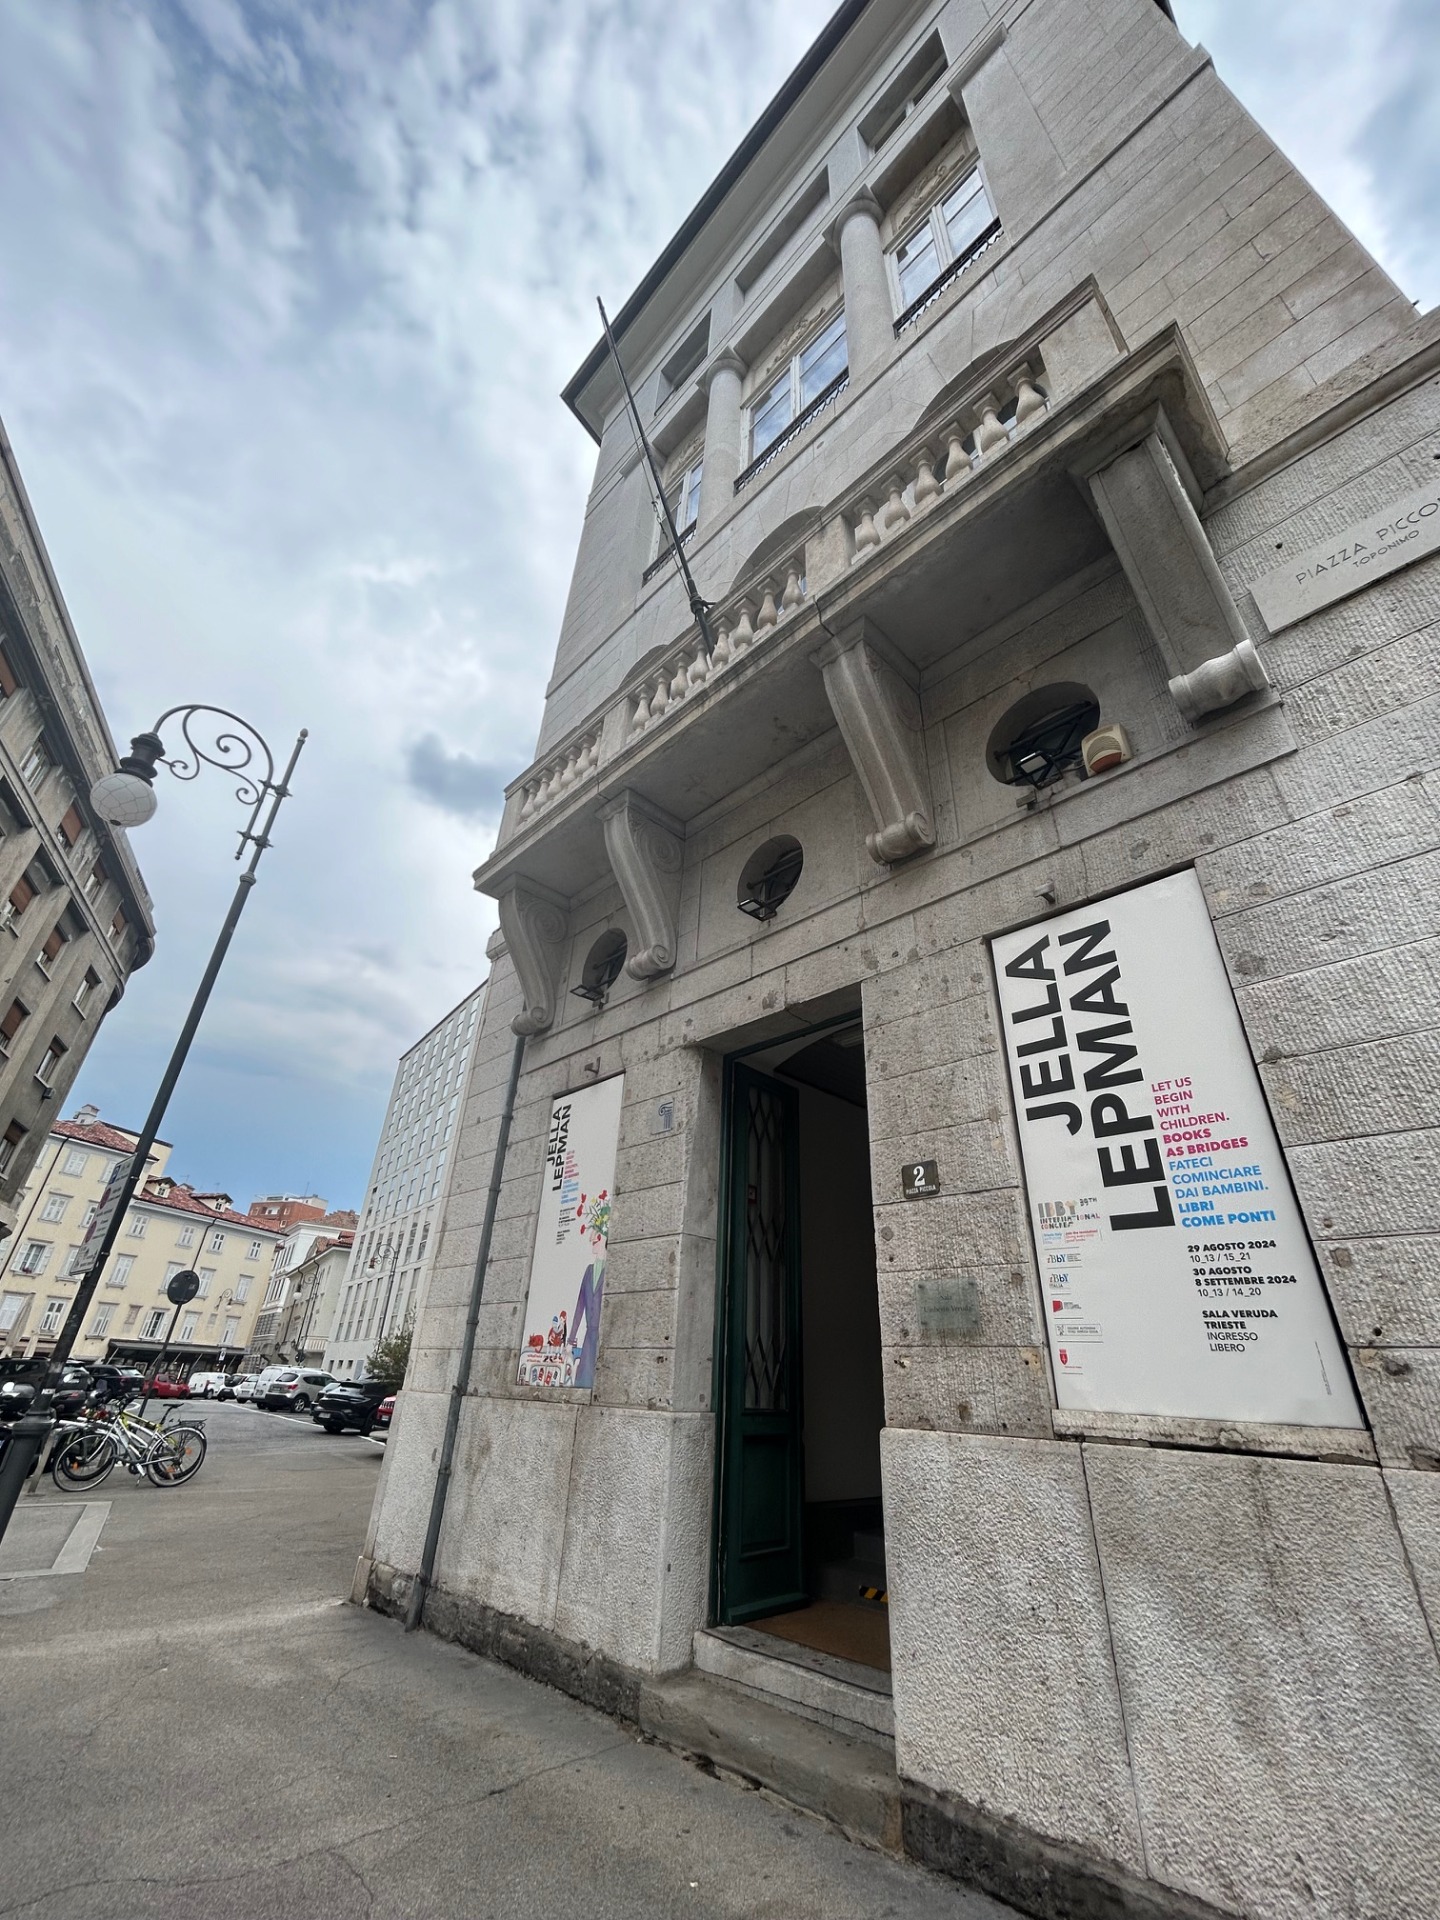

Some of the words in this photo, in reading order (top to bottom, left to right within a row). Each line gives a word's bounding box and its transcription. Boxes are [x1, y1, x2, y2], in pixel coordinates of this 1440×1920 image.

[1353, 530, 1419, 568] TOPONIMO
[1296, 543, 1368, 584] PIAZZA
[1005, 934, 1083, 1136] JELLA
[1058, 919, 1176, 1231] LEPMAN
[1151, 1081, 1171, 1092] LET
[1176, 1077, 1192, 1088] US
[1154, 1090, 1193, 1105] BEGIN
[1157, 1104, 1190, 1118] WITH
[1160, 1112, 1230, 1130] CHILDREN.
[547, 1106, 562, 1165] JELLA
[1163, 1128, 1212, 1144] BOOKS
[552, 1104, 572, 1191] LEPMAN
[1166, 1146, 1184, 1158] AS
[1187, 1137, 1249, 1155] BRIDGES
[1169, 1156, 1213, 1171] FATECI
[913, 1166, 926, 1187] 2
[1172, 1165, 1262, 1185] COMINCIARE
[1175, 1187, 1199, 1199] DAI
[1202, 1180, 1269, 1196] BAMBINI.
[1038, 1200, 1077, 1218] IBBY
[1178, 1200, 1215, 1213] LIBRI
[1182, 1215, 1225, 1228] COME
[1228, 1210, 1276, 1224] PONTI
[1187, 1245, 1200, 1253] 29
[1203, 1242, 1245, 1251] AGOSTO
[1248, 1240, 1277, 1249] 2024
[1190, 1253, 1215, 1264] 10_13
[1224, 1252, 1251, 1262] 15_21
[1192, 1268, 1206, 1276] 30
[1208, 1266, 1252, 1275] AGOSTO
[1204, 1276, 1265, 1286] SETTEMBRE
[1266, 1275, 1297, 1284] 2024
[1198, 1288, 1224, 1298] 10_13
[1232, 1287, 1262, 1298] 14_20
[1202, 1310, 1230, 1318] SALA
[1231, 1309, 1278, 1318] VERUDA
[1204, 1321, 1246, 1329] TRIESTE
[1207, 1332, 1258, 1341] INGRESSO
[1210, 1343, 1246, 1352] LIBERO
